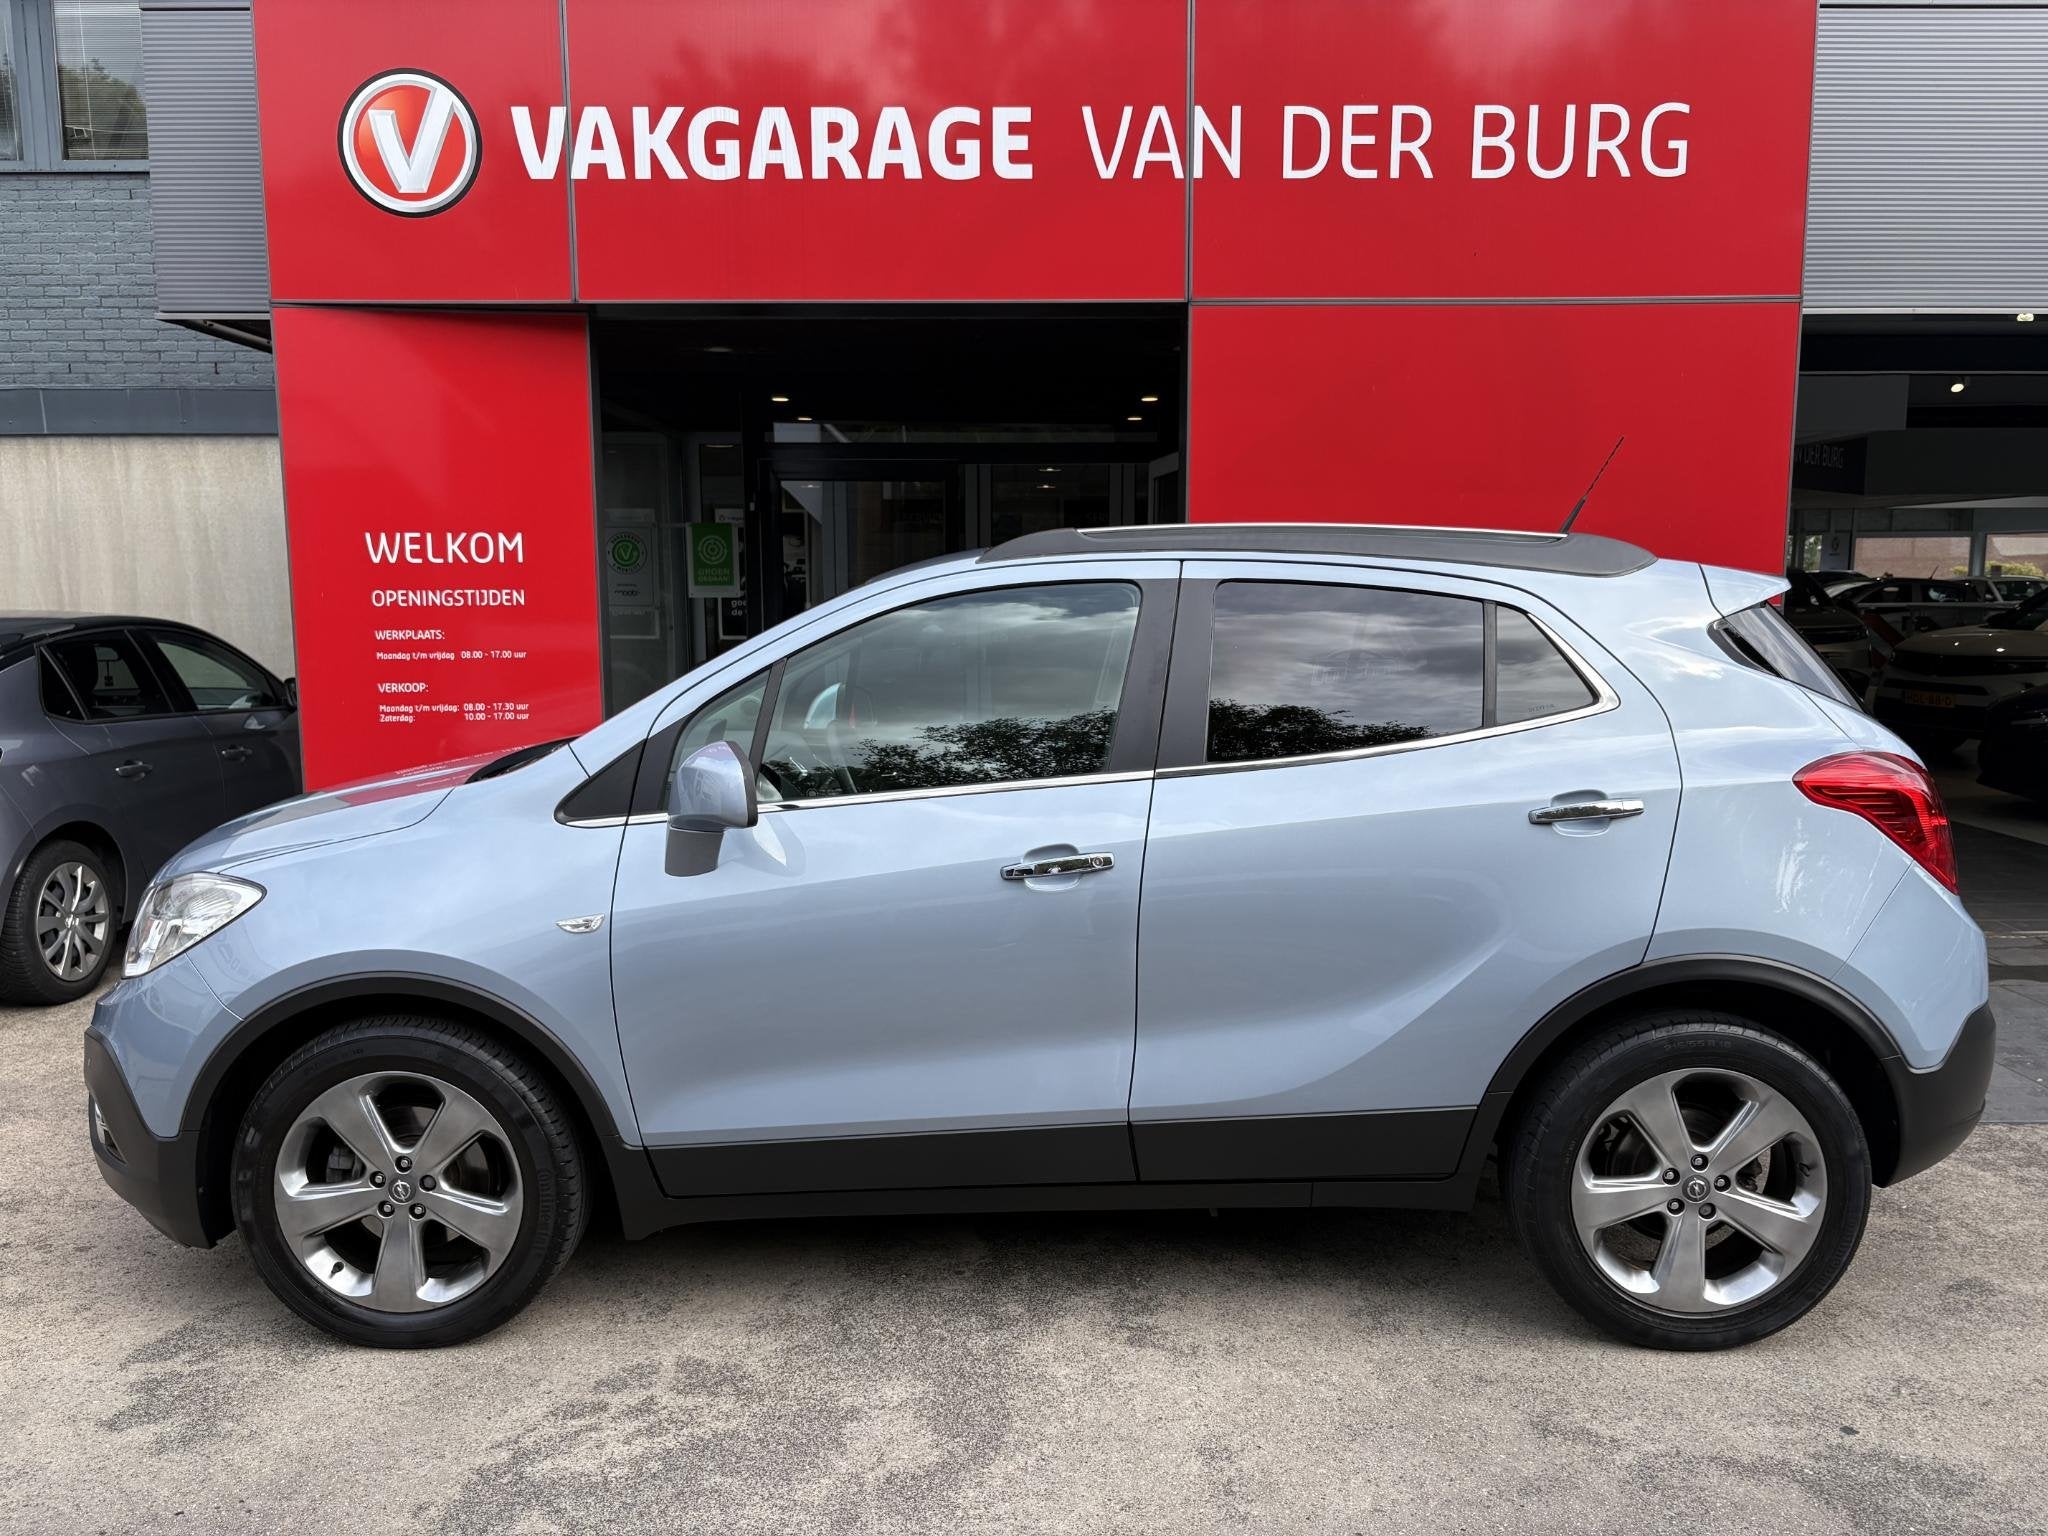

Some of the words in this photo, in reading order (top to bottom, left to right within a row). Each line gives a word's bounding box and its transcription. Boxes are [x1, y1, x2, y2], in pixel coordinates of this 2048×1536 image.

[511, 105, 1034, 181] VAKGARAGE
[1081, 105, 1242, 179] VAN
[1282, 104, 1434, 179] DER
[1471, 102, 1690, 179] BURG
[364, 531, 524, 564] WELKOM
[371, 589, 525, 607] OPENINGSTIJDEN
[375, 629, 445, 641] WERKPLAATS:
[376, 651, 411, 661] Maandag
[412, 652, 428, 660] t/m
[429, 651, 455, 661] vrijdag
[461, 650, 483, 659] 08.00
[490, 650, 513, 659] 17.00
[377, 682, 429, 693] VERKOOP:
[379, 704, 414, 714] Maandag
[415, 704, 431, 712] t/m
[431, 703, 460, 713] vrijdag:
[463, 703, 486, 711] 08.00
[493, 702, 515, 711] 17.30
[516, 703, 529, 711] uur
[380, 713, 416, 723] Zaterdag:
[464, 712, 486, 721] 10.00
[493, 712, 515, 720] 17.00
